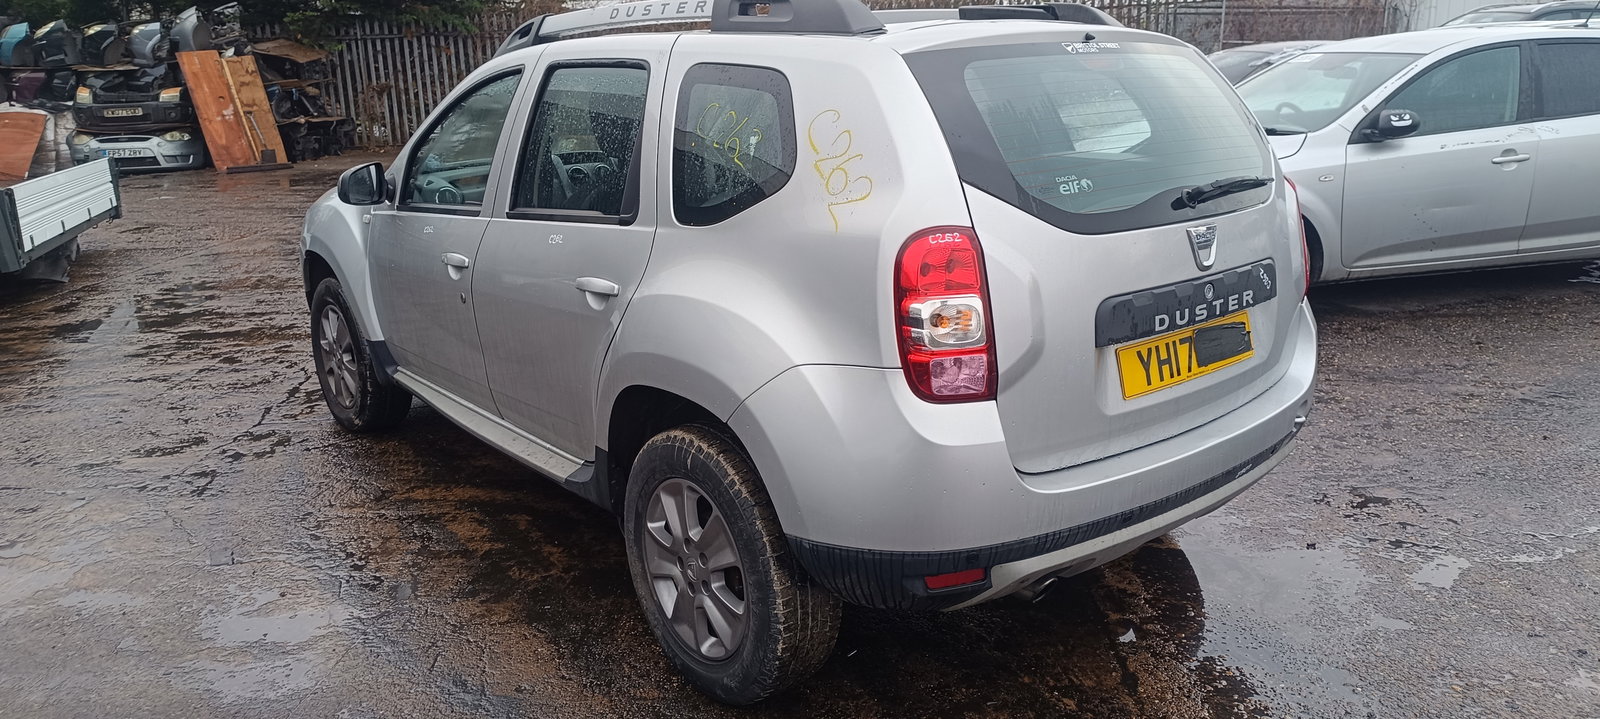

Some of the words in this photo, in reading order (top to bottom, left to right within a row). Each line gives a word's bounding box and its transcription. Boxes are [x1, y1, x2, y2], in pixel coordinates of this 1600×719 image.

[610, 1, 707, 19] DUSTER
[807, 109, 873, 232] C262
[1055, 174, 1078, 183] DACIA
[1060, 180, 1081, 195] elf
[929, 232, 963, 244] C262
[1155, 289, 1254, 332] DUSTER
[1136, 335, 1193, 387] YH17
